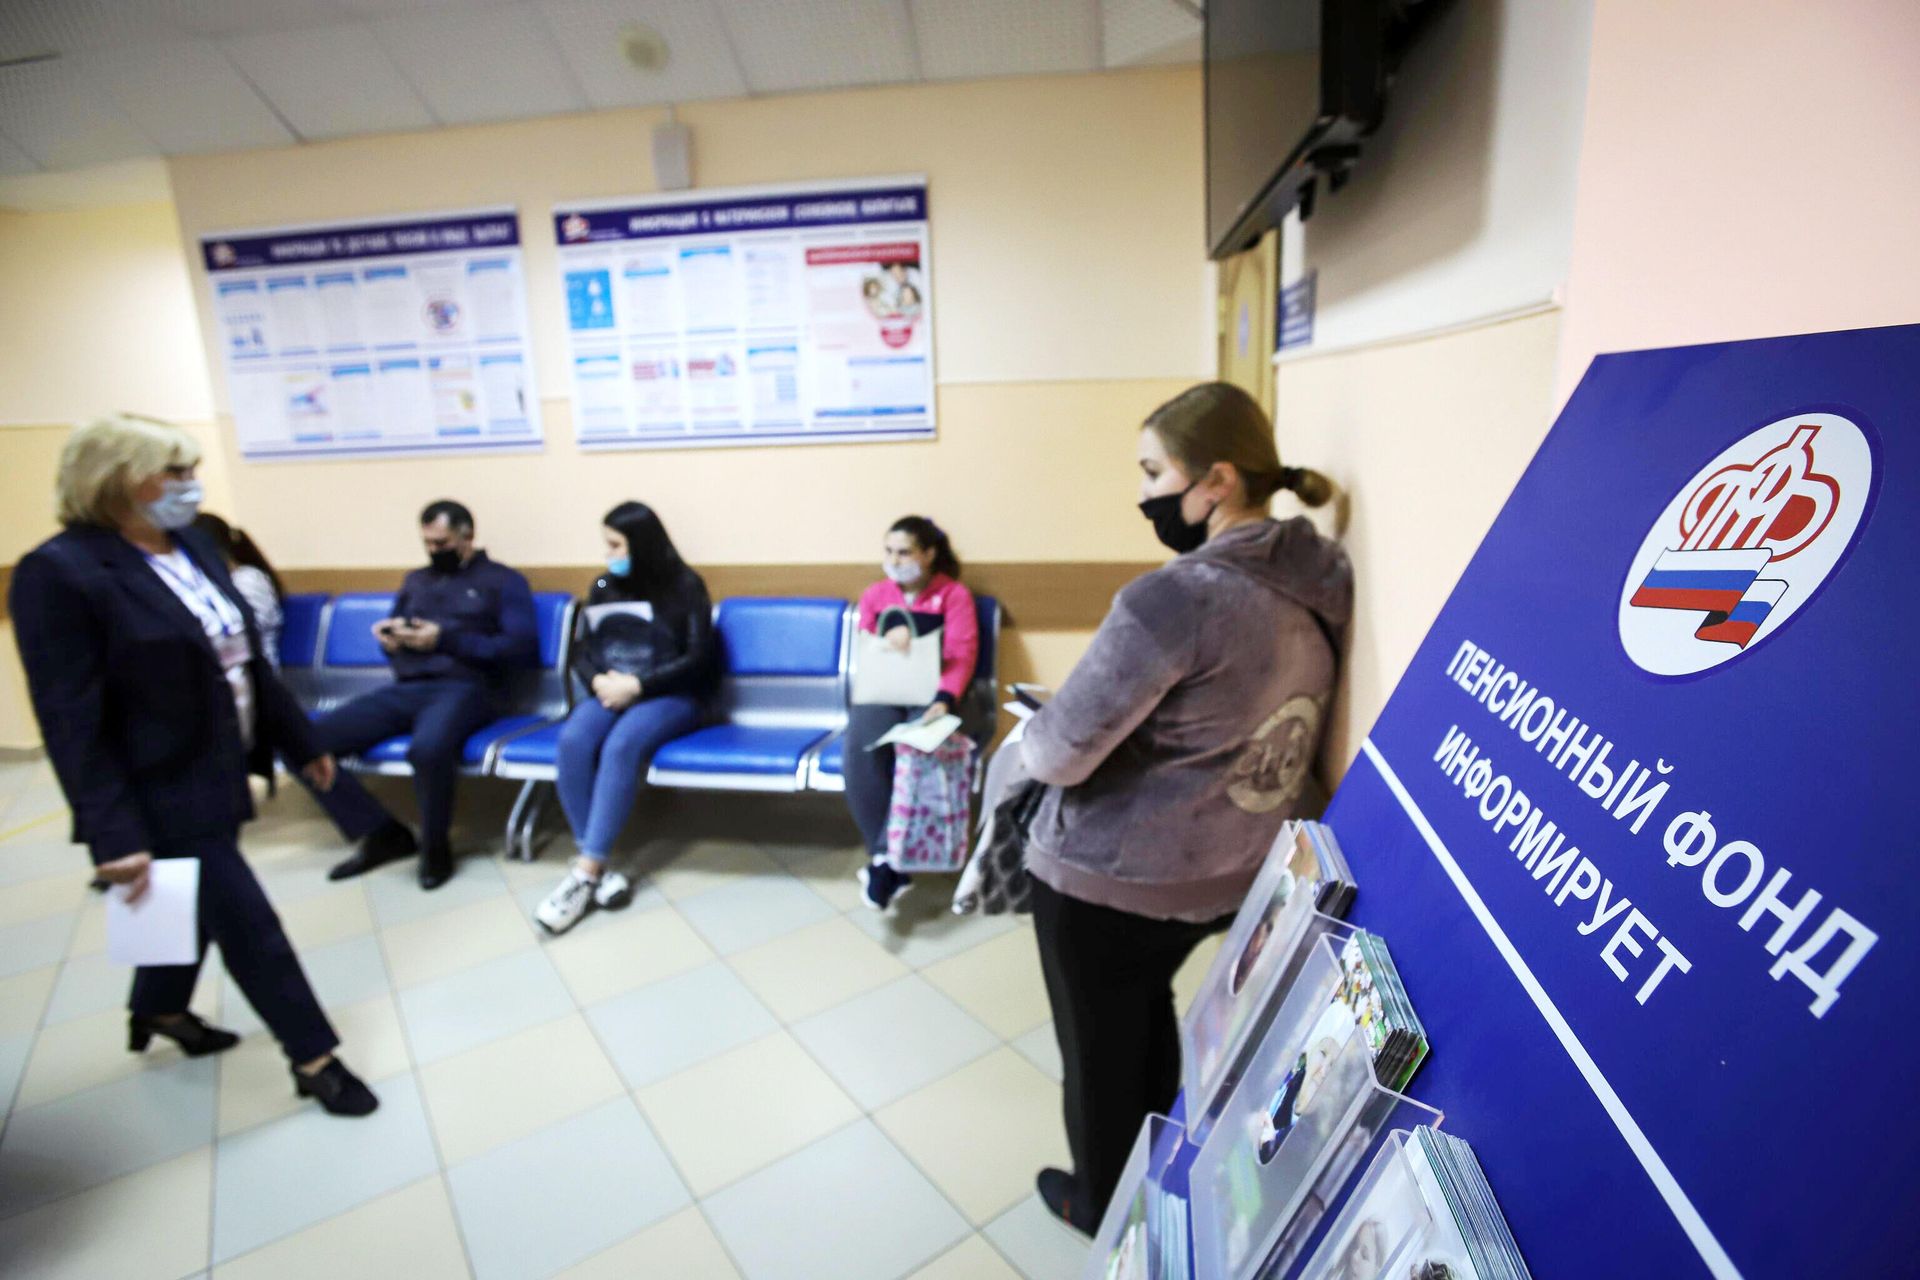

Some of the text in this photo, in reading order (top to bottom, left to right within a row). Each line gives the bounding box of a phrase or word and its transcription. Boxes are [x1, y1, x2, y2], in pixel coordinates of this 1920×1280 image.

[1434, 725, 1692, 1005] ИНФОРМИРУЕТ
[1446, 640, 1878, 1018] ПЕНСИОННЫЙ ФОНД
